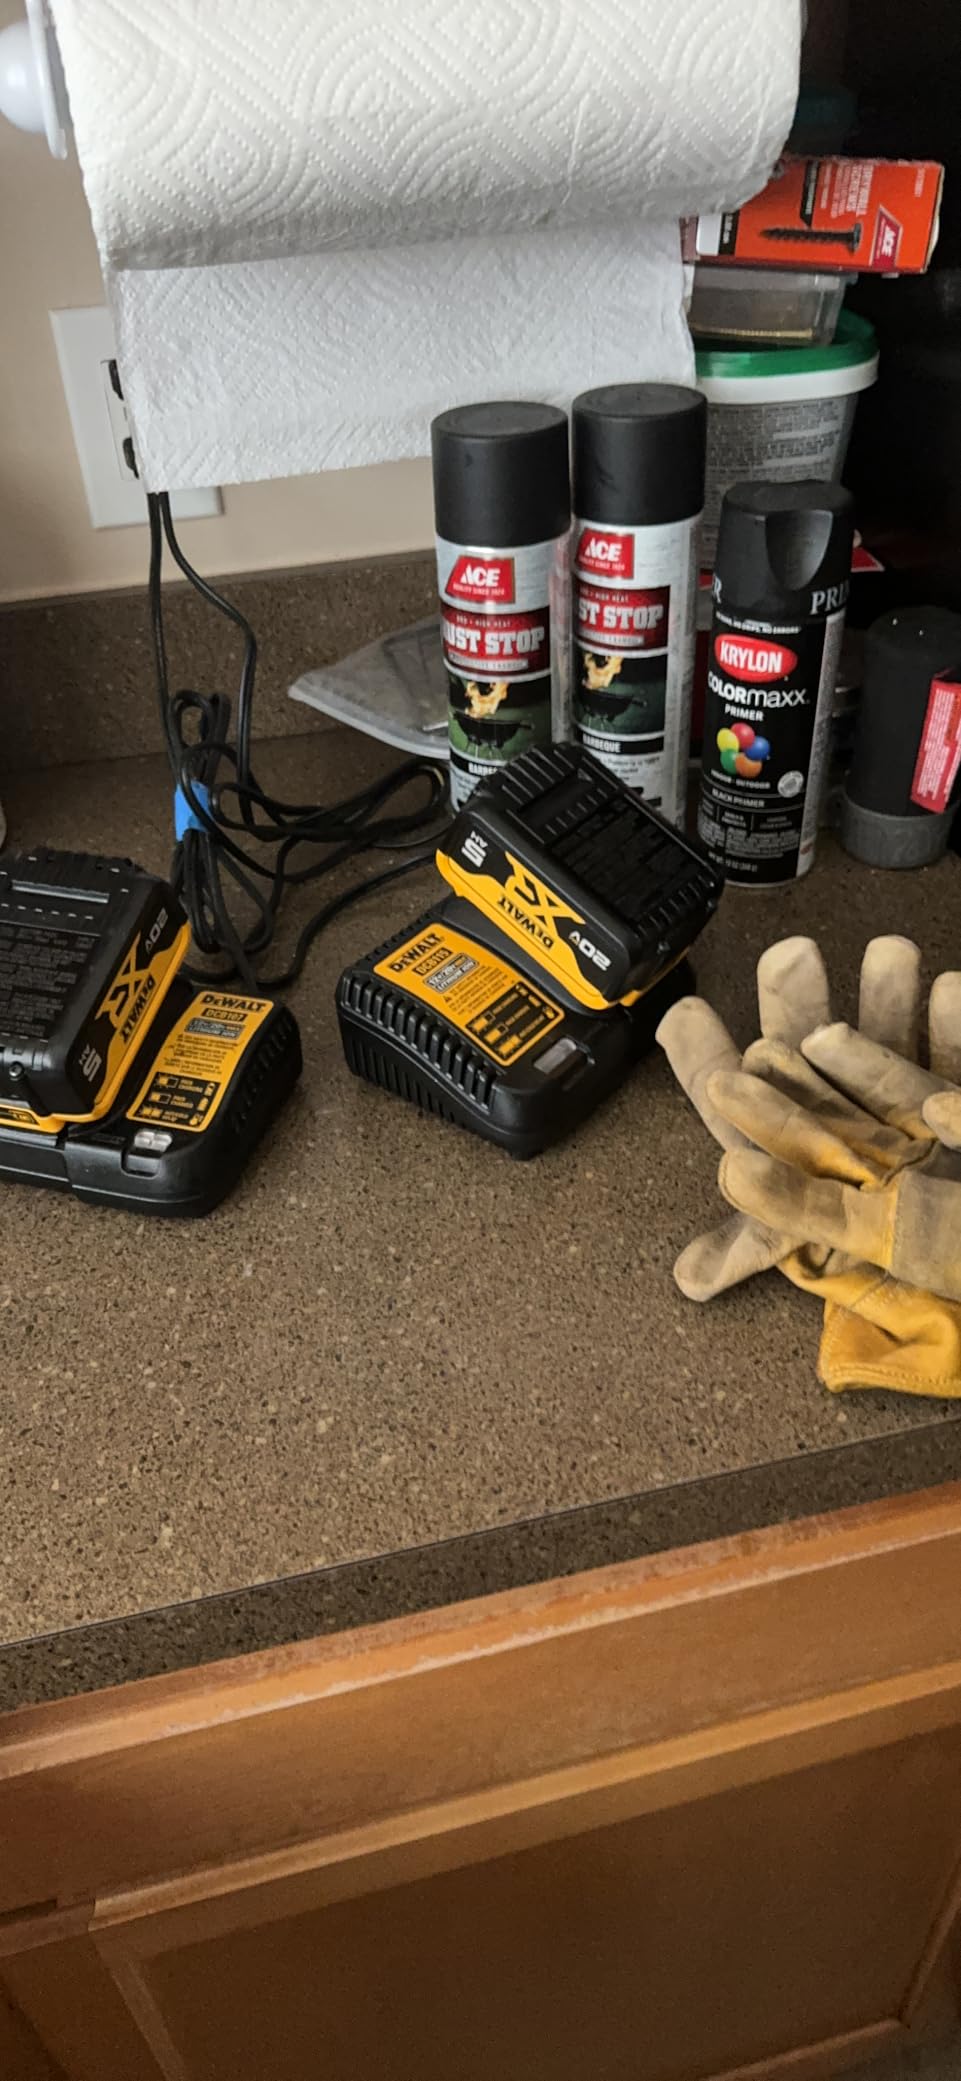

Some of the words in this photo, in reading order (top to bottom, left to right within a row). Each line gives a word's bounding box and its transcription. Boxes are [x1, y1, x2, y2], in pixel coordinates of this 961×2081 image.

[881, 225, 896, 257] ACE
[584, 537, 623, 562] ACE
[460, 562, 502, 587] ACE
[603, 603, 665, 630] STOP
[442, 619, 481, 653] UST
[485, 626, 545, 656] STOP
[719, 640, 783, 674] KRYLON
[724, 703, 764, 721] PRIMER
[582, 733, 621, 753] BARBEQUE
[460, 839, 486, 868] 5
[82, 1050, 103, 1082] 5
